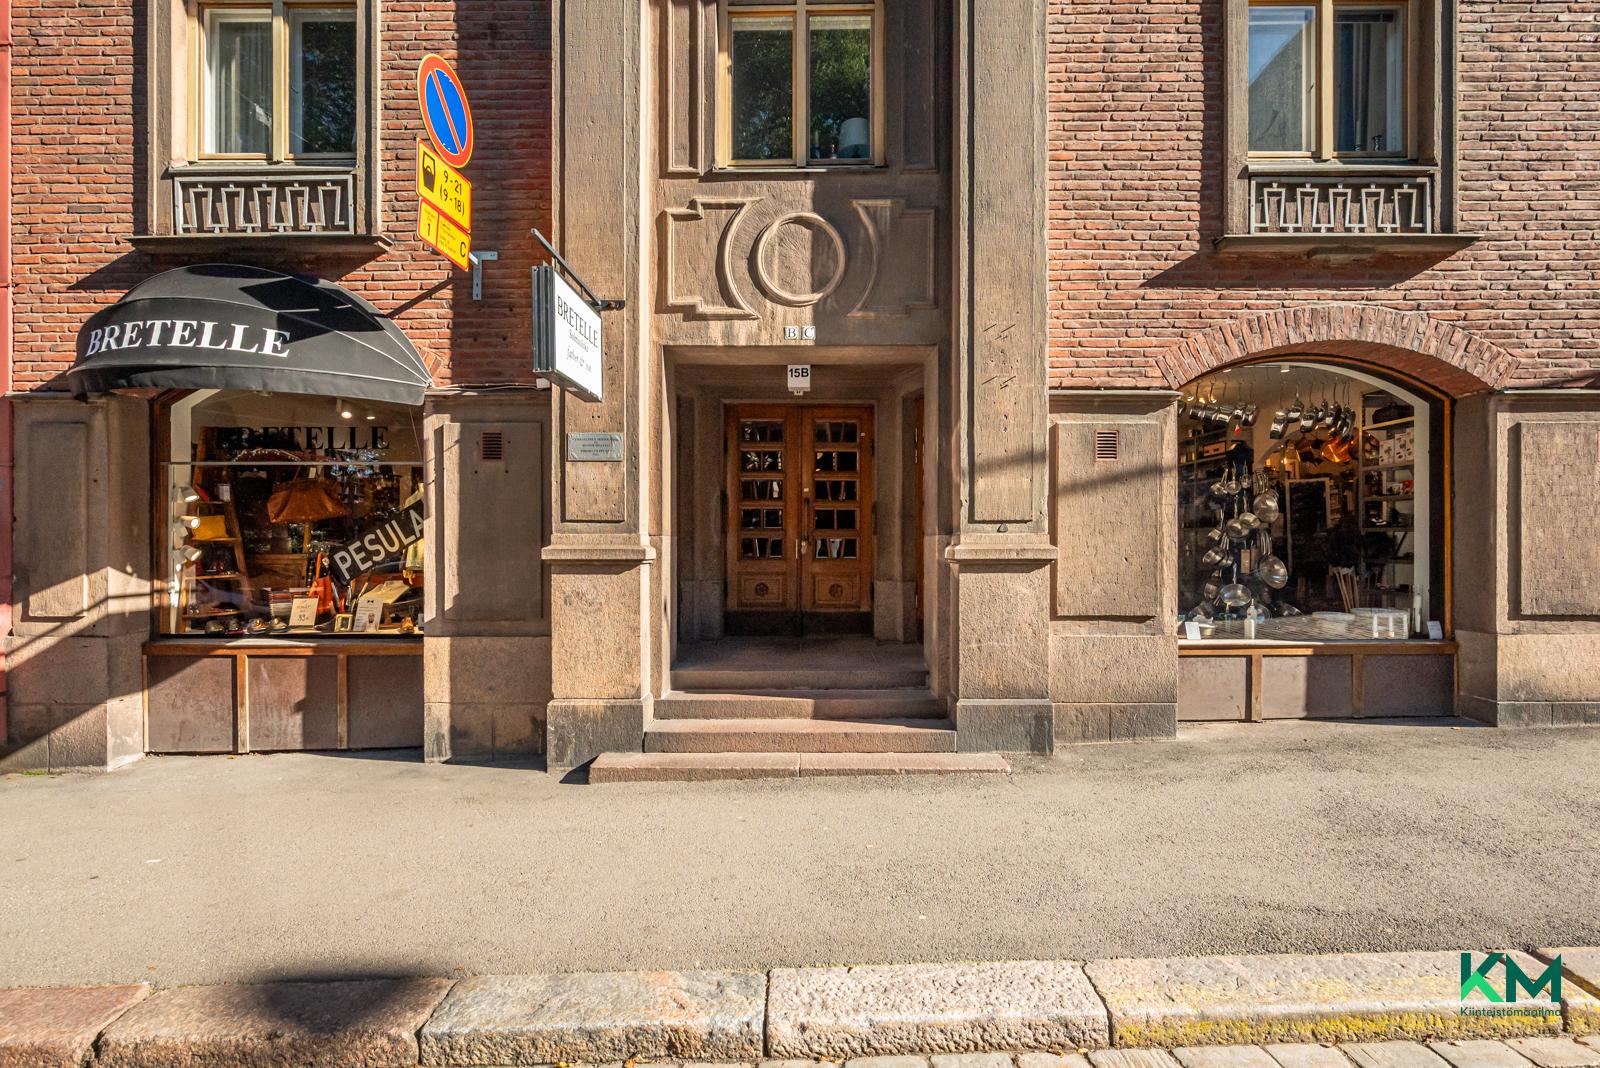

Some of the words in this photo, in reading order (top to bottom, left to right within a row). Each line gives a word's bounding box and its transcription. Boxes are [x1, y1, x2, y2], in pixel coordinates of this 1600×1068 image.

[459, 241, 467, 258] C
[557, 295, 598, 348] BRETELLE
[787, 327, 797, 338] B
[804, 327, 815, 338] C
[85, 319, 291, 358] BRETELLE
[788, 368, 809, 378] 15B
[333, 509, 424, 580] PESULA
